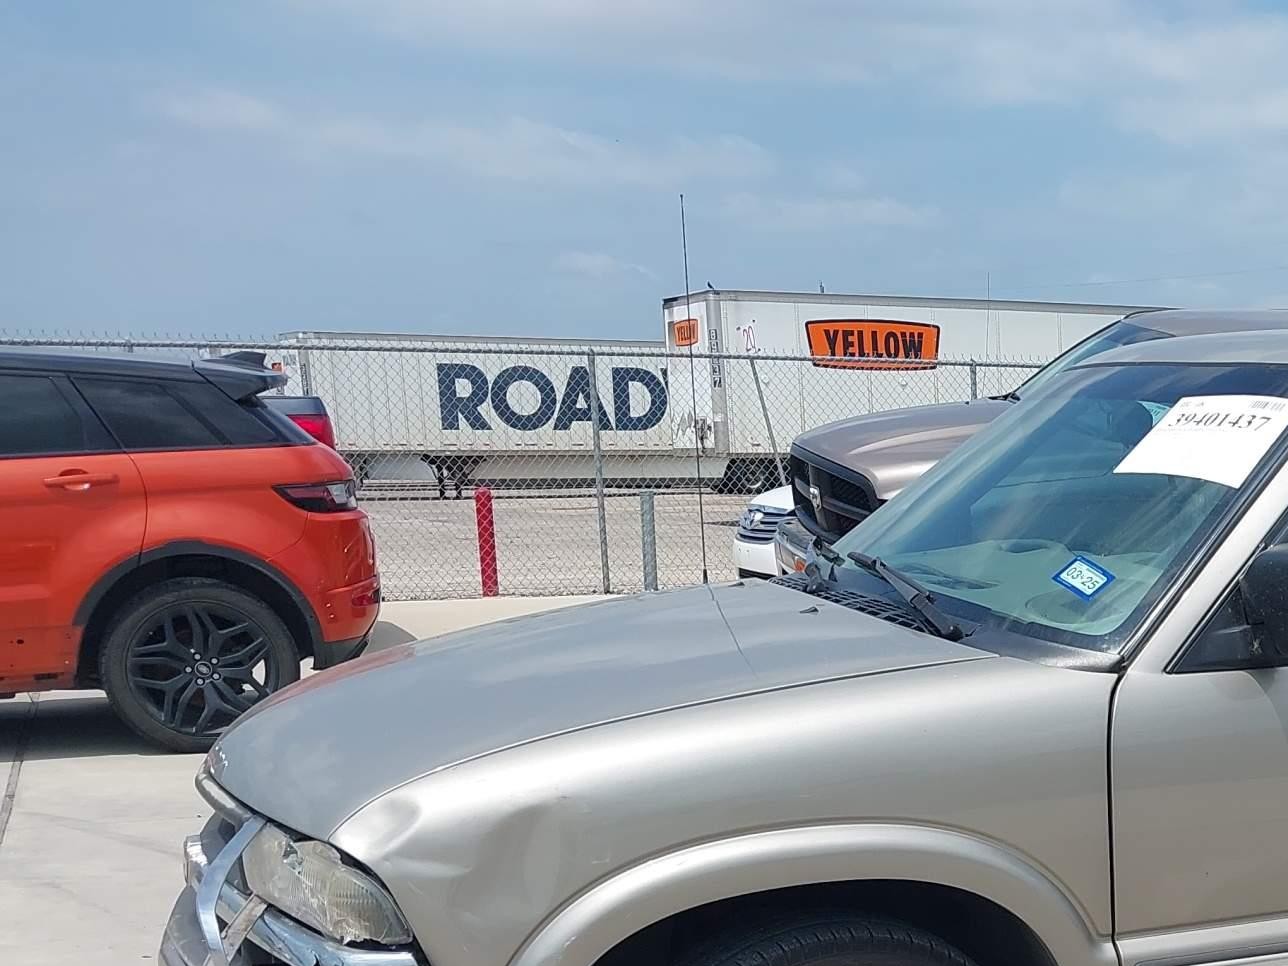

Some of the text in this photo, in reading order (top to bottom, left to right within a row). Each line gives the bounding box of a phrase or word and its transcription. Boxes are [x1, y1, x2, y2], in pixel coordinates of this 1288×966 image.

[823, 329, 924, 360] YELLOW
[437, 363, 669, 431] ROAD
[1168, 412, 1272, 431] 39401437
[1066, 567, 1099, 590] 03 25
